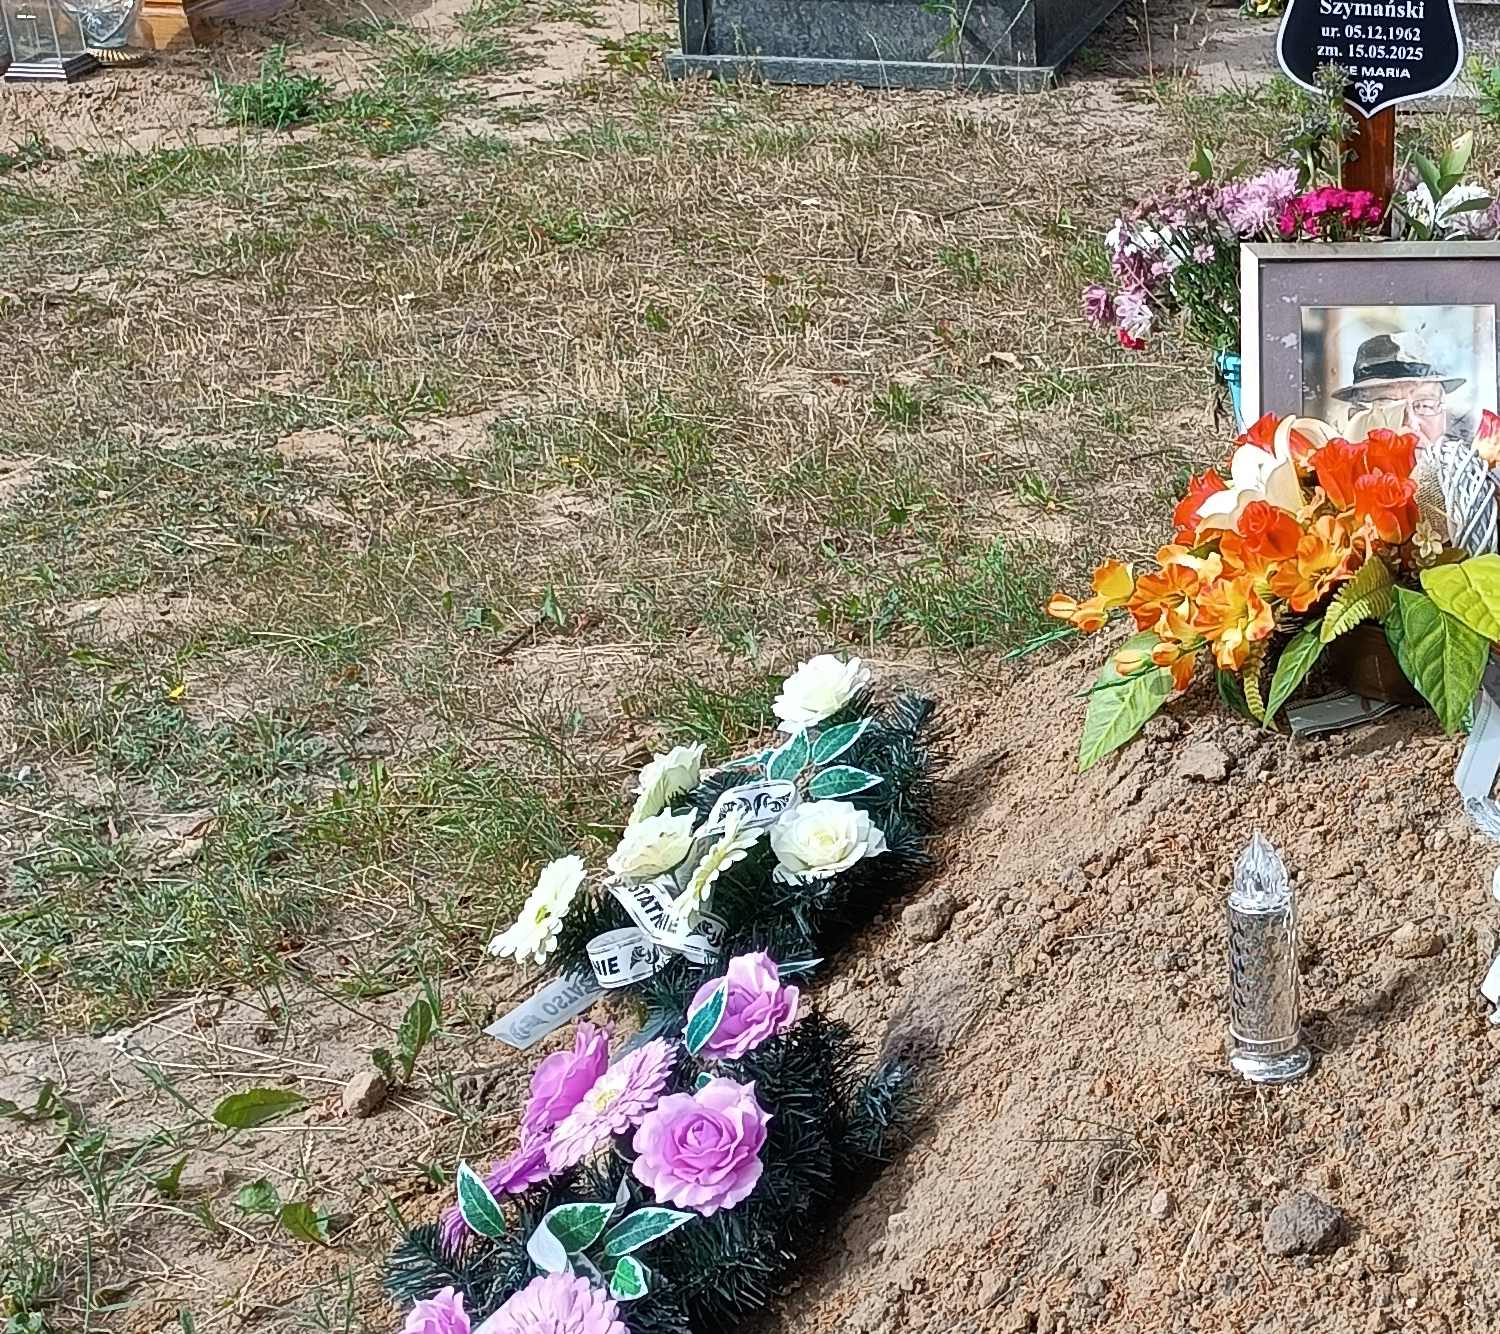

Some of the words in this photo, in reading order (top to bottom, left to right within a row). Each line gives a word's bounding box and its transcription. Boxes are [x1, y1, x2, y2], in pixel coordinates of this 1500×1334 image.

[1321, 26, 1340, 39] ur.
[1344, 26, 1421, 42] 05.12.1962
[1317, 46, 1343, 57] zm.
[1348, 44, 1424, 61] 15.05.2025
[1361, 66, 1411, 78] MARIA
